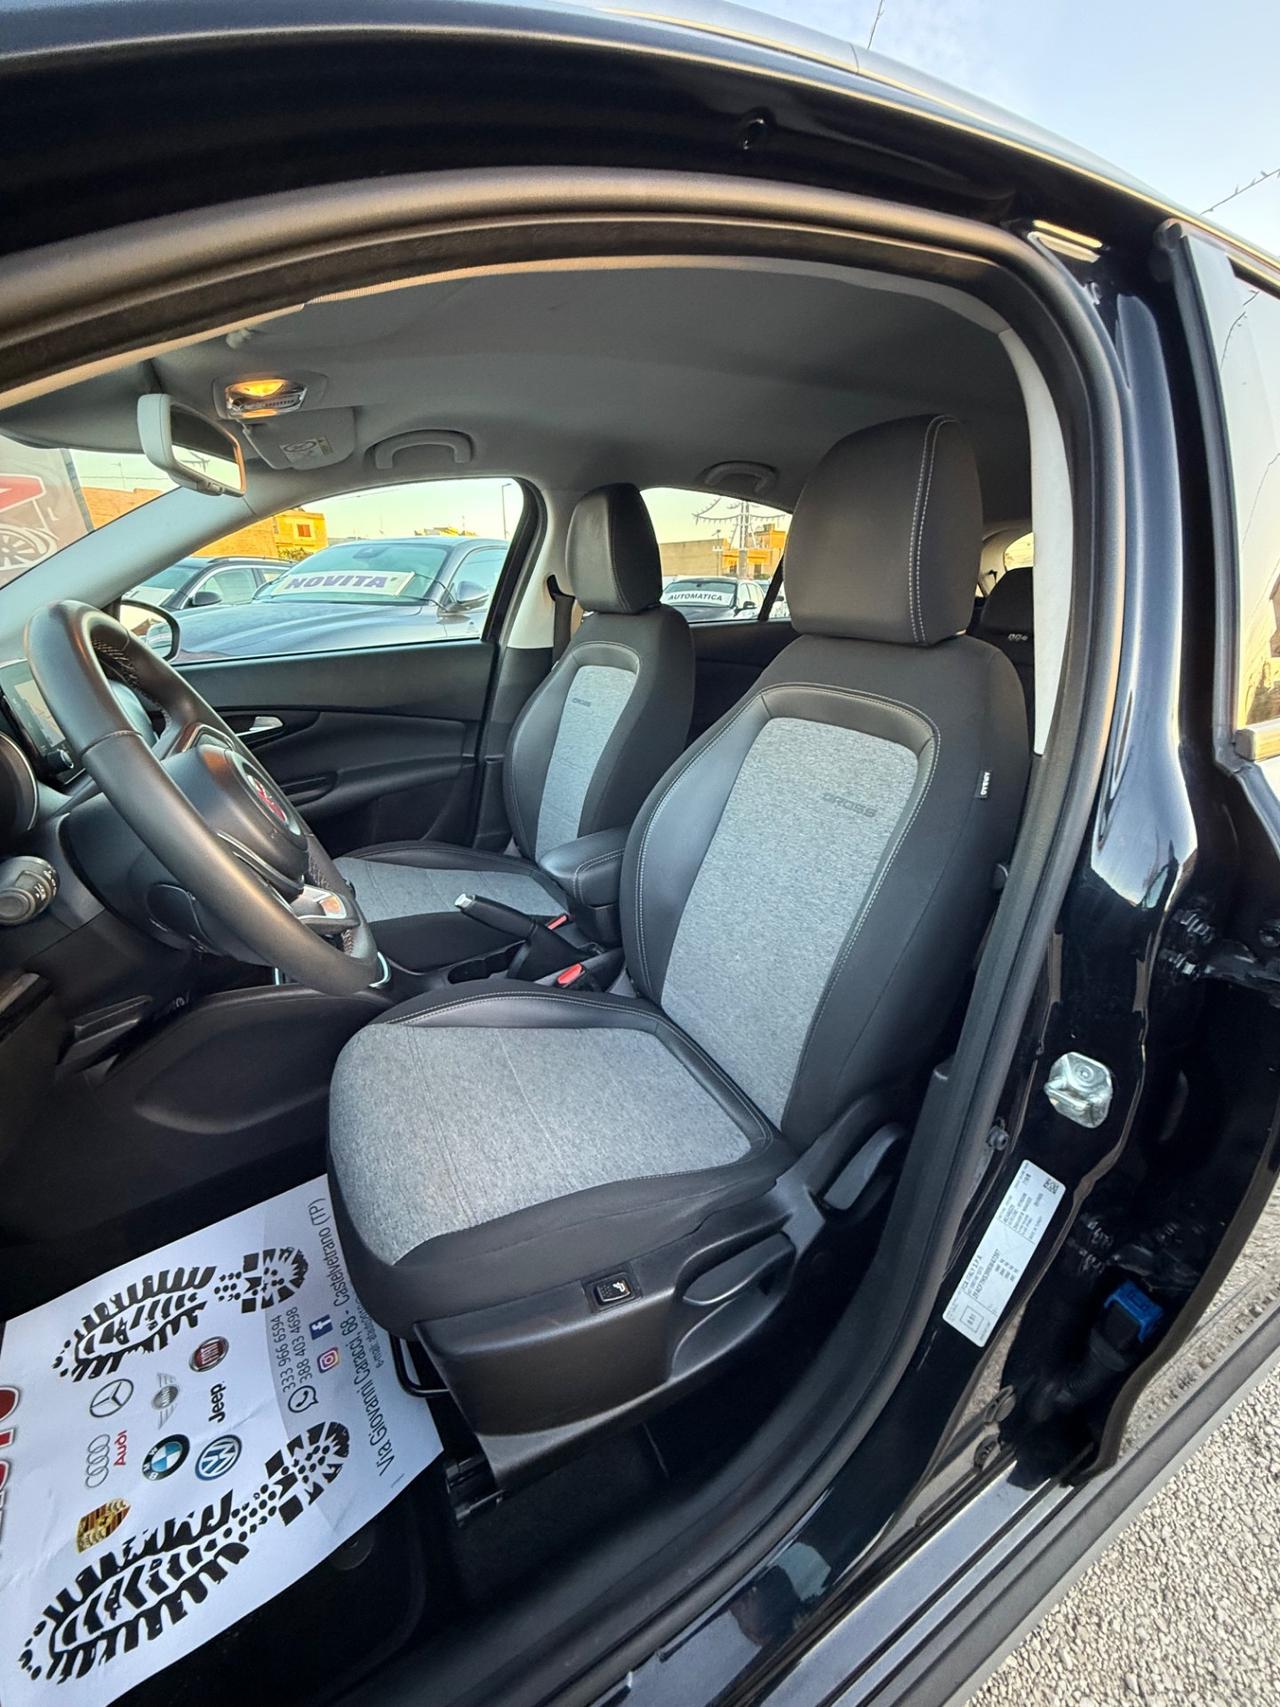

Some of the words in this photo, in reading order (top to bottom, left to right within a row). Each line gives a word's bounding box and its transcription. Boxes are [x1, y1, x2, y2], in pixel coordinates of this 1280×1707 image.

[668, 593, 722, 601] AUTOMATICA
[308, 1197, 331, 1227] (TP)
[318, 1227, 350, 1307] Castelvetrano
[271, 1314, 287, 1344] 6594
[286, 1306, 301, 1334] 4698
[340, 1316, 358, 1337] 68
[276, 1343, 290, 1368] 966
[292, 1335, 306, 1358] 403
[345, 1330, 371, 1386] Caracci,
[279, 1367, 297, 1393] 333
[296, 1358, 313, 1384] 388
[208, 1383, 228, 1424] Jeep
[356, 1379, 388, 1447] Giovanni
[113, 1430, 127, 1467] Audi
[376, 1438, 395, 1477] Via
